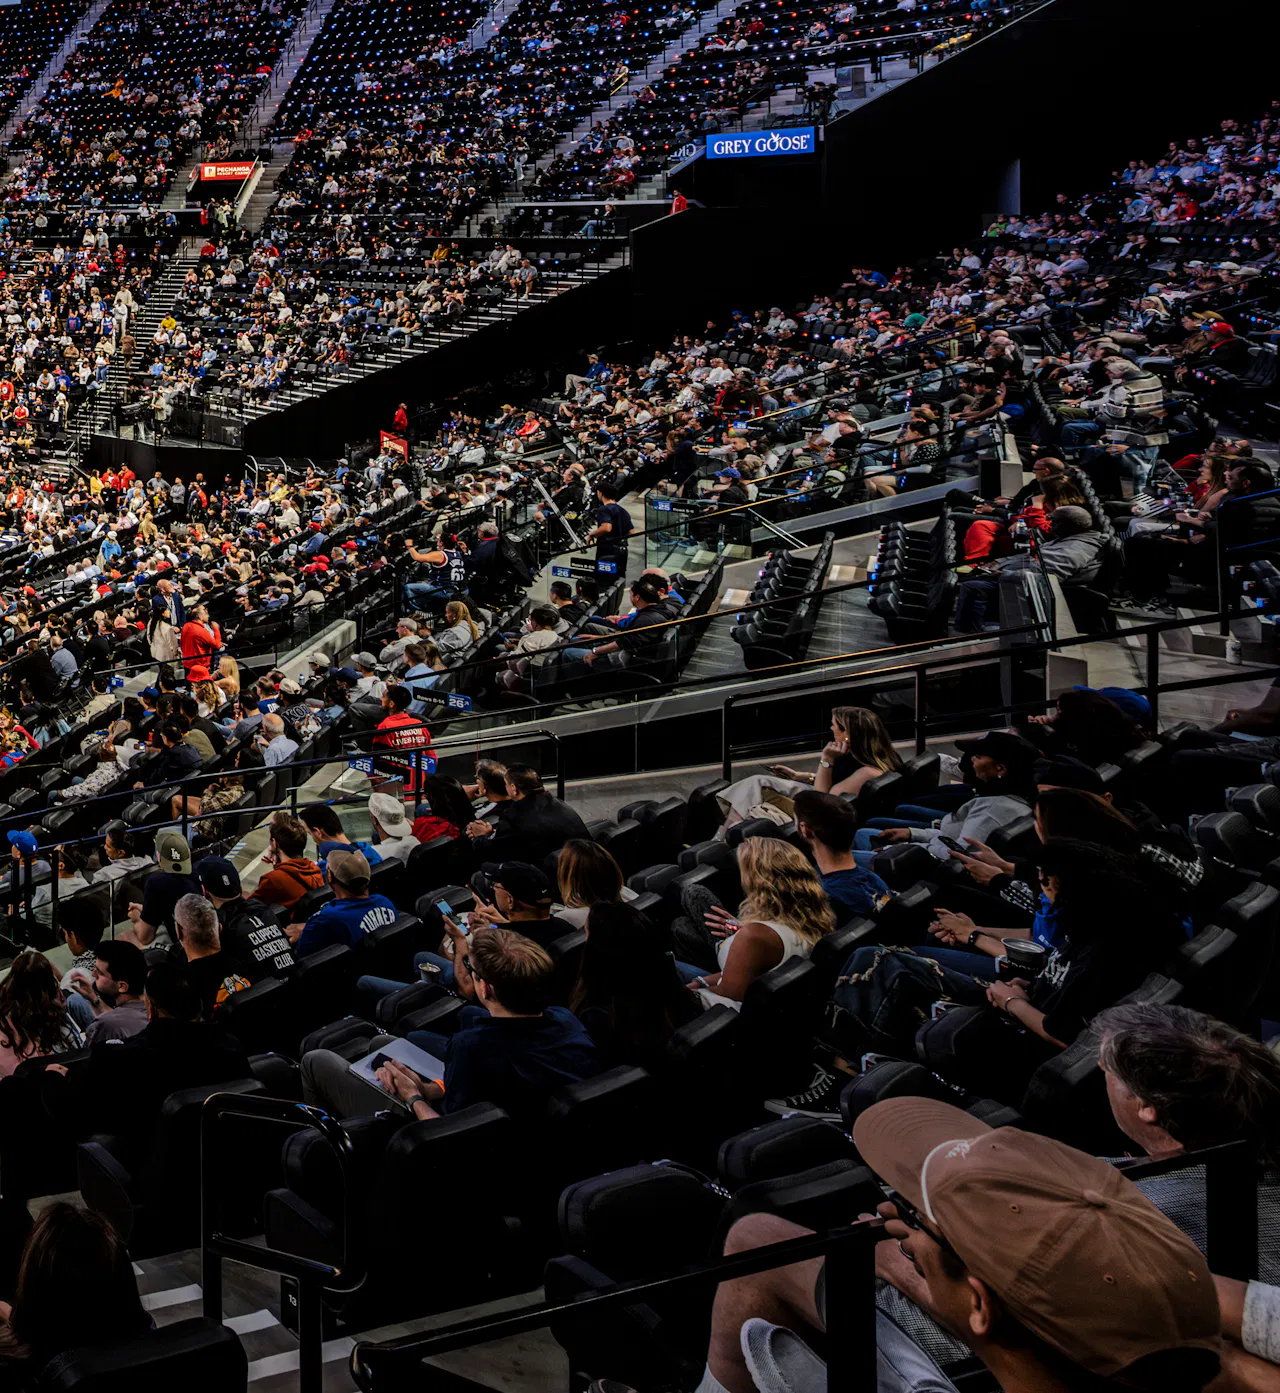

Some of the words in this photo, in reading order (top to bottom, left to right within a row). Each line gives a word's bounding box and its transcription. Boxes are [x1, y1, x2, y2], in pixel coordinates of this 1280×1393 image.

[714, 138, 751, 155] GREY
[755, 133, 810, 152] GOOSE
[557, 569, 569, 577] 26
[599, 563, 611, 572] 26
[449, 697, 464, 708] 26
[355, 759, 371, 772] 26
[248, 915, 265, 928] LA
[359, 907, 396, 933] TURNER
[248, 924, 282, 946] CLIPPERS
[273, 952, 295, 970] CLUB
